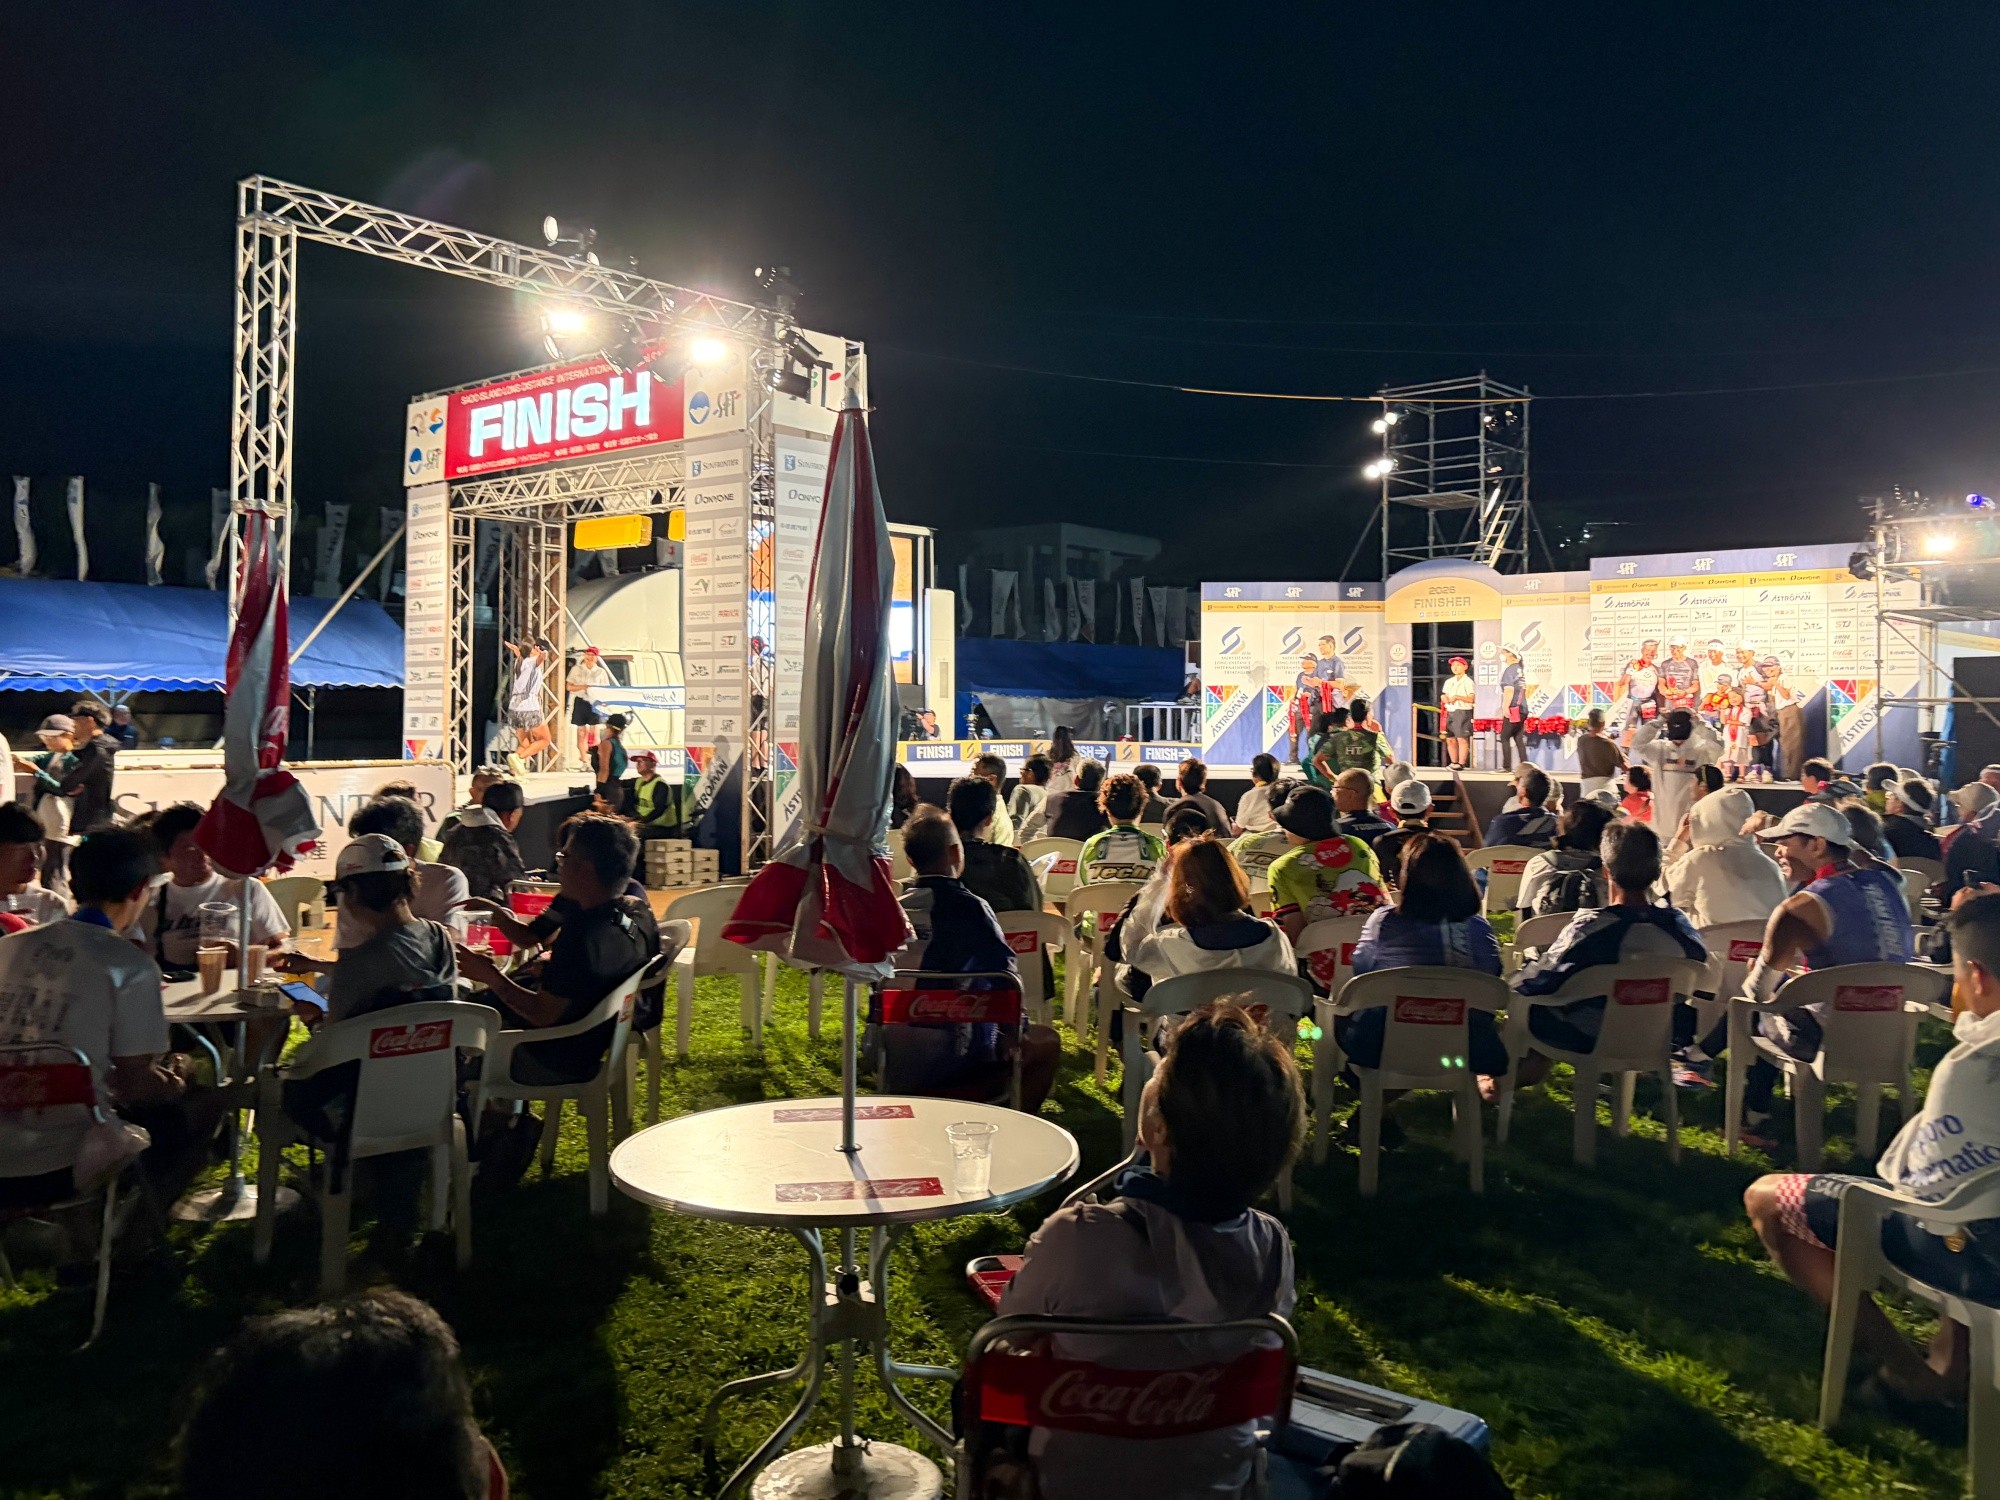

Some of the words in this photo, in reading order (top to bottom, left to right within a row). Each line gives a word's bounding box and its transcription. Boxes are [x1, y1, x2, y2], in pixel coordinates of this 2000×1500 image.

[469, 371, 650, 457] FINISH
[1414, 596, 1471, 608] FINISHER
[916, 745, 953, 759] FINISH
[1145, 747, 1179, 761] FINISH
[909, 994, 991, 1019] Coca-Cola
[372, 1024, 448, 1054] Coca-Cola
[1040, 1369, 1225, 1426] Coca-Cola
